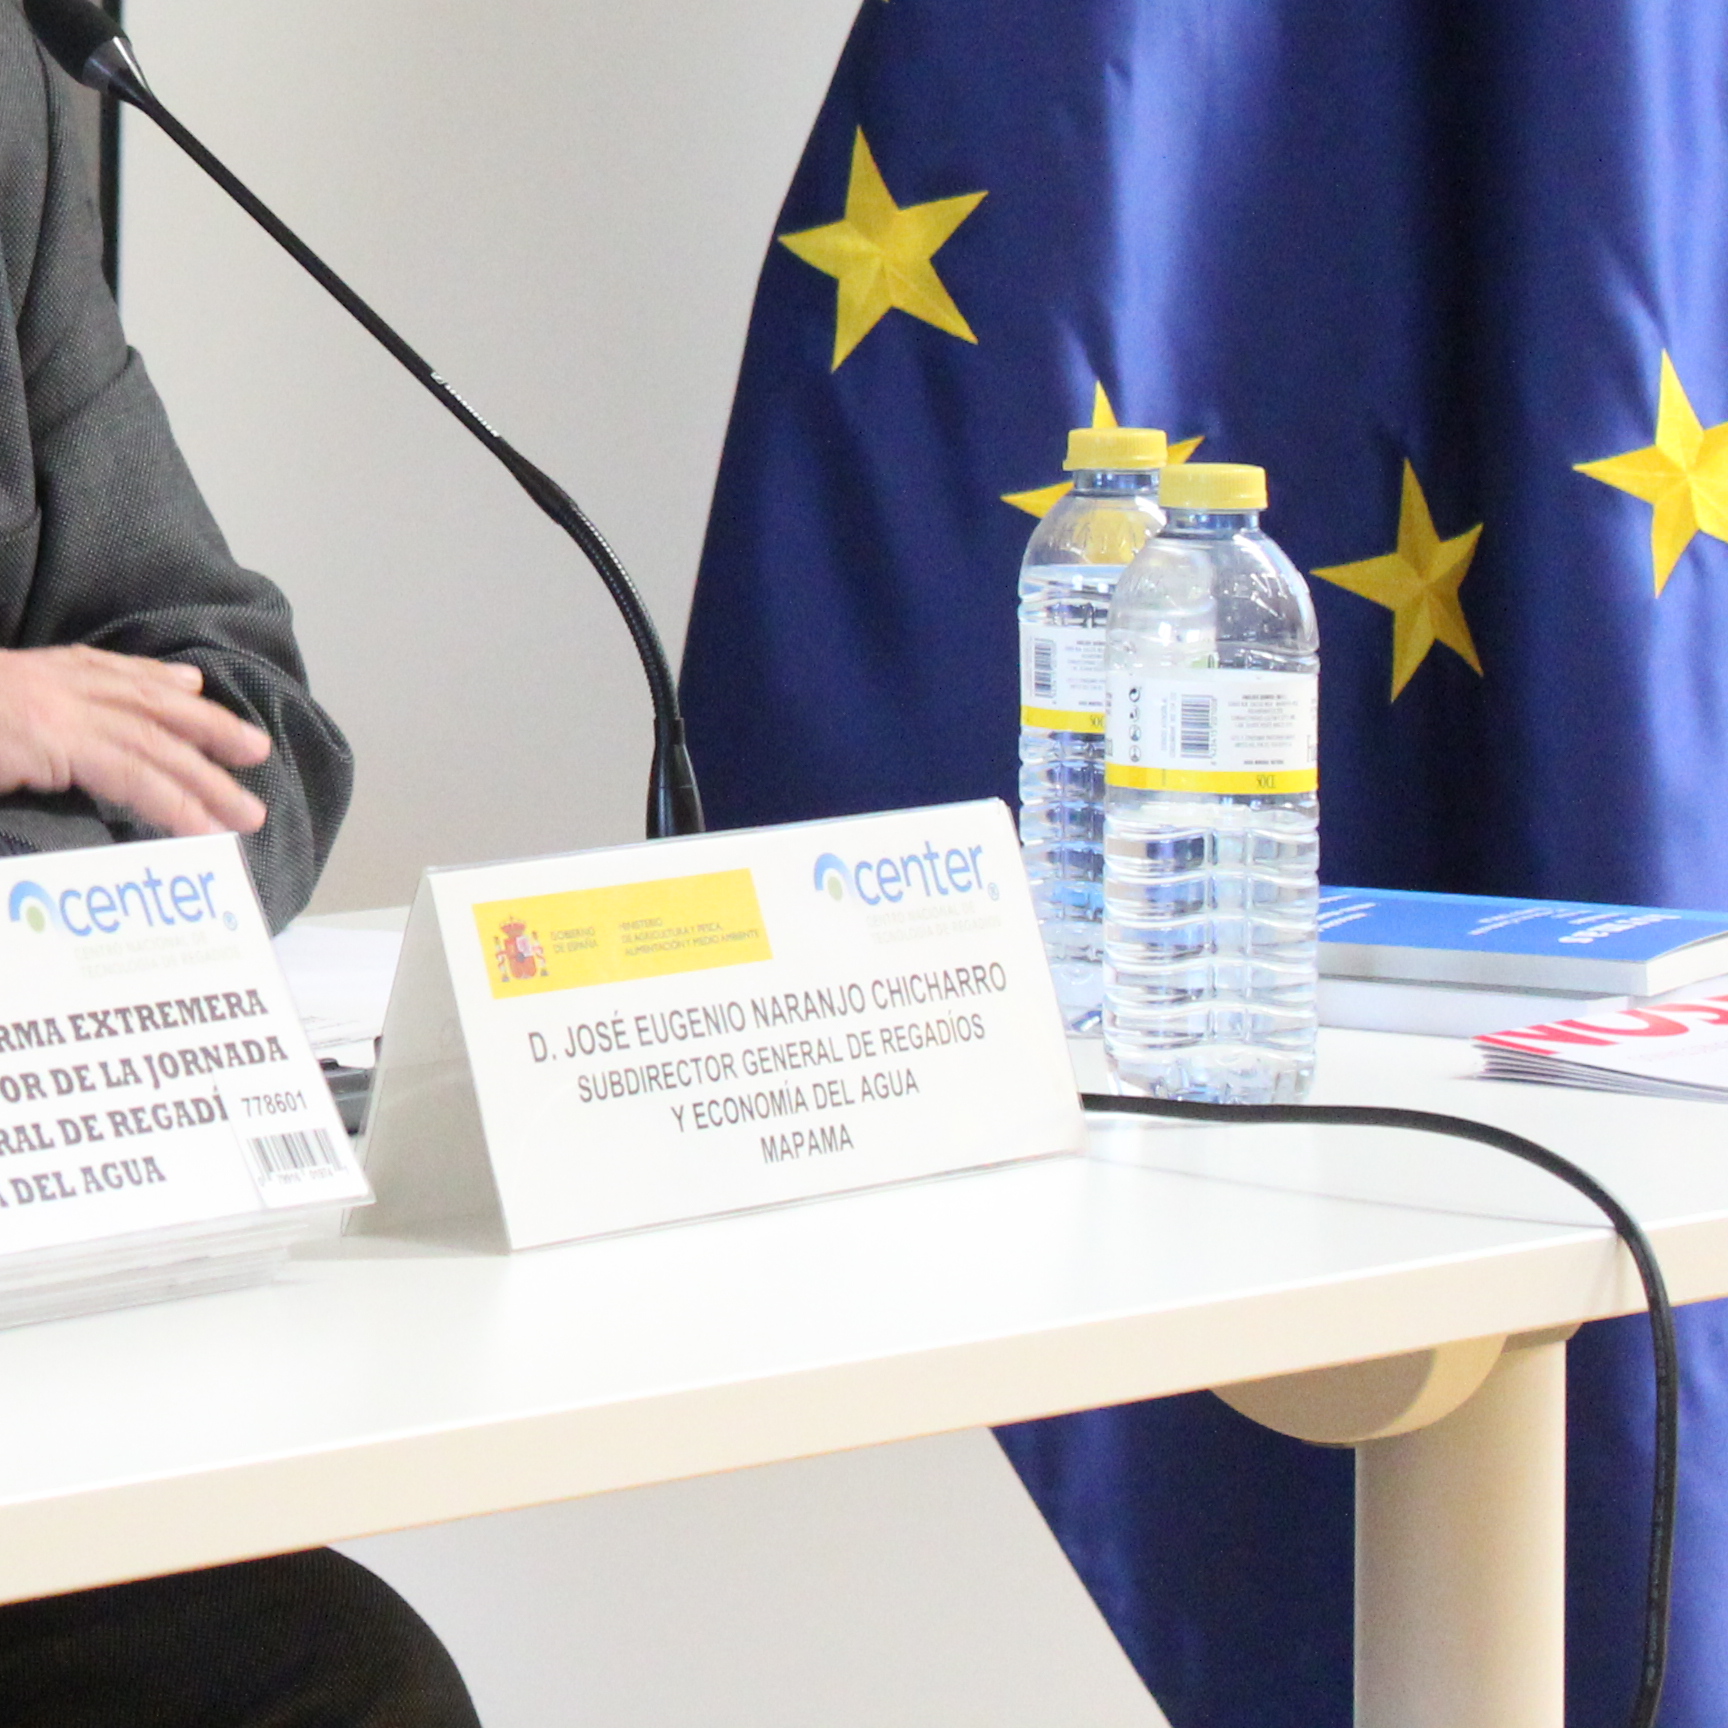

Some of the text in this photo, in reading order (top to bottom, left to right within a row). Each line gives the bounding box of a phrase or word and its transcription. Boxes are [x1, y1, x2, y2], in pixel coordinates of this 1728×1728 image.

[854, 840, 983, 906] center
[59, 867, 215, 936] center
[619, 917, 663, 931] MINISTERIO
[549, 926, 596, 941] GOBIERNO
[552, 937, 598, 954] DE ESPAÑA
[621, 933, 633, 944] DE
[634, 926, 689, 942] AGRICULTURA
[624, 939, 686, 956] ALIMENTACIÓN
[693, 935, 720, 946] MEDIO
[721, 928, 760, 942] AMBIENTE
[67, 988, 269, 1043] EXTREMERA
[528, 961, 1007, 1063] D. JOSÉ EUGENIO NARANJO CHICHARRO
[49, 1064, 97, 1096] DE
[98, 1058, 143, 1088] LA
[142, 1035, 289, 1089] JORNADA
[577, 1009, 986, 1103] SUBDIRECTOR GENERAL DE REGADÍOS
[57, 1115, 106, 1146] DE
[106, 1085, 229, 1139] REGADÍ
[241, 1089, 308, 1119] 778601
[670, 1068, 920, 1133] Y ECONOMÍA DEL AGUA
[760, 1123, 854, 1164] MAPAMA
[9, 1171, 77, 1206] DEL
[79, 1155, 167, 1193] AGUA
